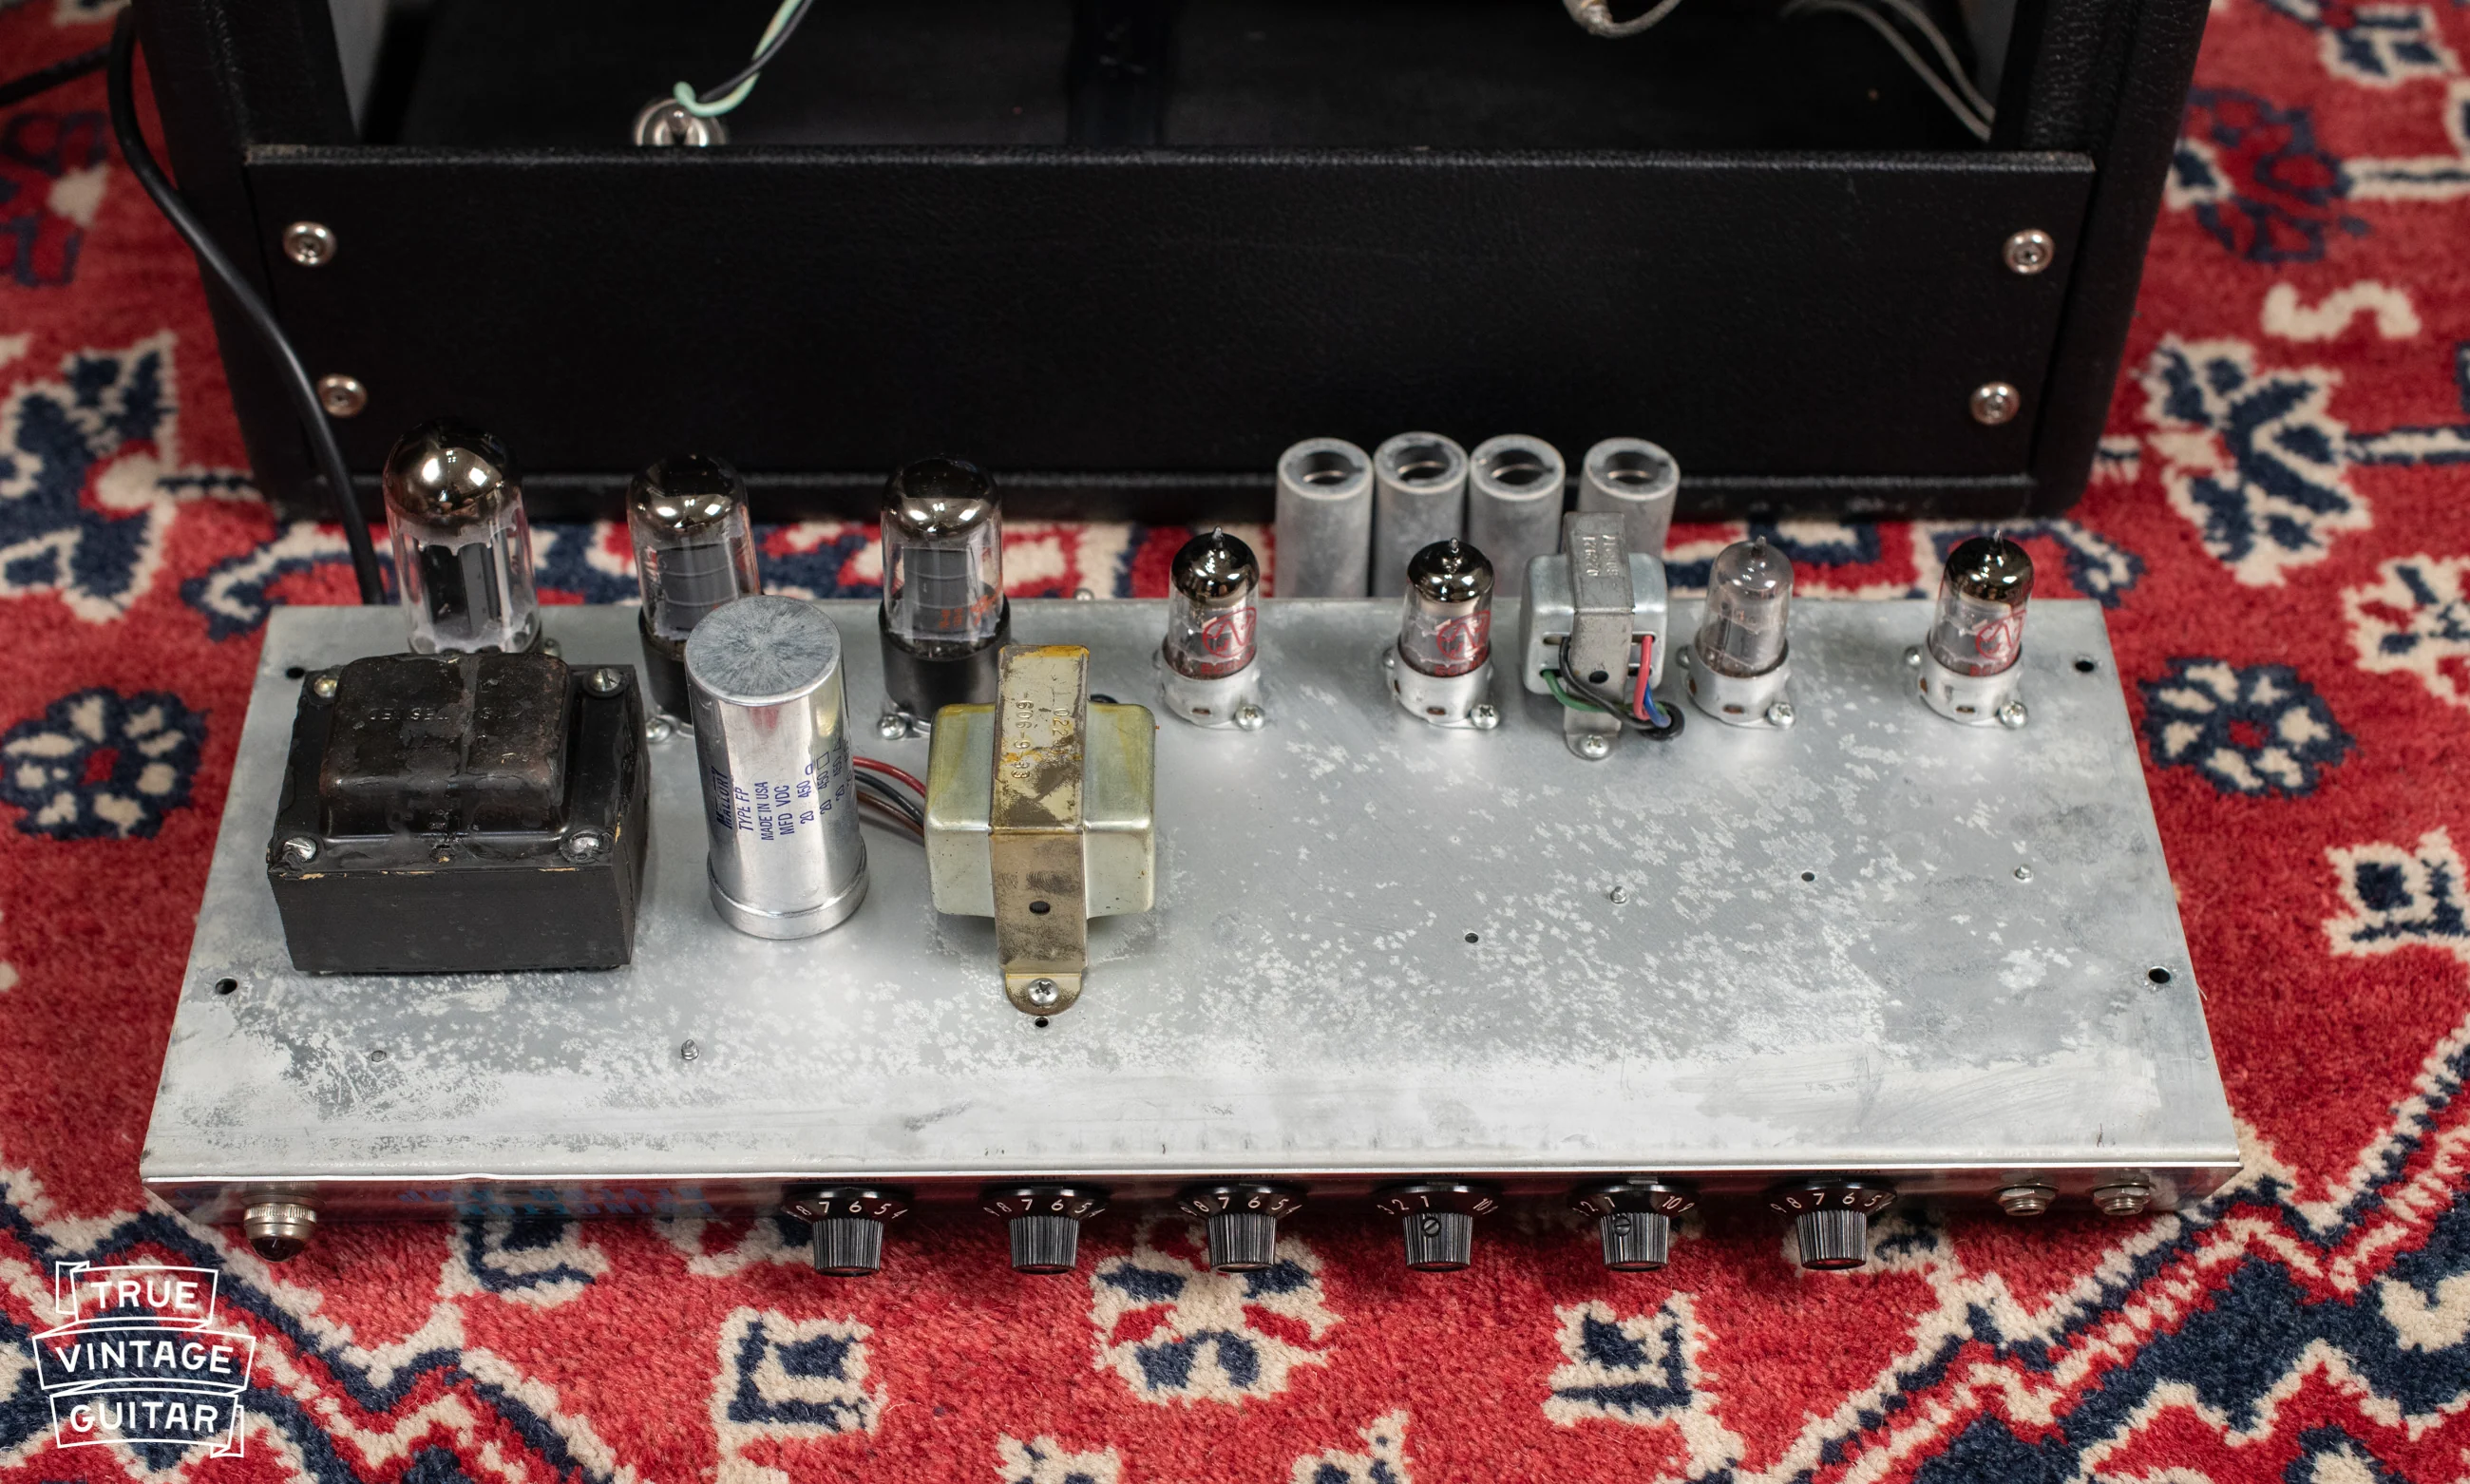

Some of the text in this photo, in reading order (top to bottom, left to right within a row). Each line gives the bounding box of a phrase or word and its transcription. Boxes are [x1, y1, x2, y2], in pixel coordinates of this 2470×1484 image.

[711, 765, 733, 830] MALLORY
[796, 780, 815, 825] 20 450
[816, 771, 832, 815] 20 450
[734, 787, 754, 831] TYPE FP
[753, 781, 775, 841] MADE IN USA
[773, 785, 795, 836] MFD VDC
[818, 1201, 830, 1214] 7
[848, 1200, 863, 1213] 6
[874, 1203, 892, 1215] 5
[1020, 1198, 1034, 1211] 7
[1051, 1198, 1064, 1211] 6
[1074, 1202, 1093, 1214] 5
[1193, 1200, 1209, 1212] 8
[1217, 1196, 1230, 1209] 7
[1247, 1195, 1261, 1208] 6
[1271, 1198, 1290, 1210] 5
[1391, 1198, 1410, 1210] 2
[1472, 1197, 1493, 1211] 10
[1580, 1201, 1599, 1211] 2
[1662, 1195, 1682, 1209] 10
[1786, 1196, 1802, 1209] 8
[1813, 1192, 1825, 1206] 7
[1842, 1191, 1855, 1205] 6
[1864, 1194, 1882, 1208] 5
